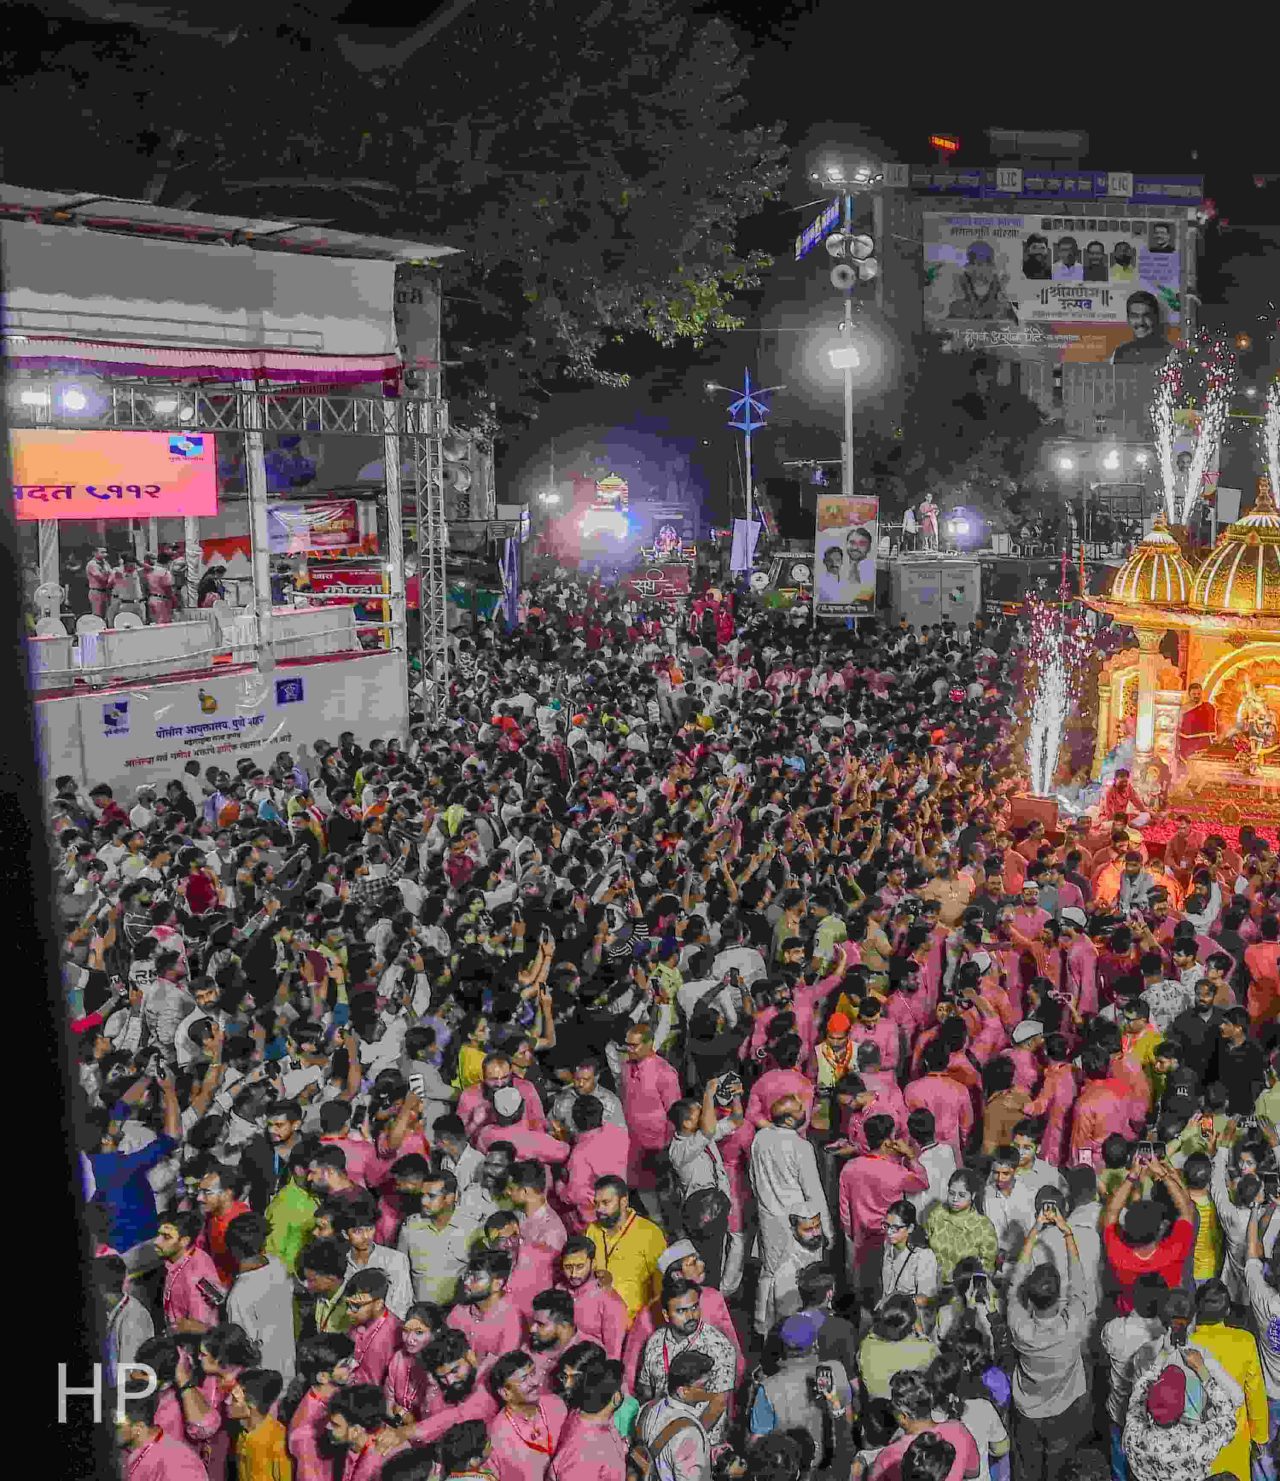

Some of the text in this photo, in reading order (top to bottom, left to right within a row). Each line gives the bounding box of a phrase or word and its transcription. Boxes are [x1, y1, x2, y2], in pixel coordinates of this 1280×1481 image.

[323, 580, 383, 594] कोल्हाप
[156, 726, 183, 739] पोलीस
[232, 716, 246, 731] पुणे
